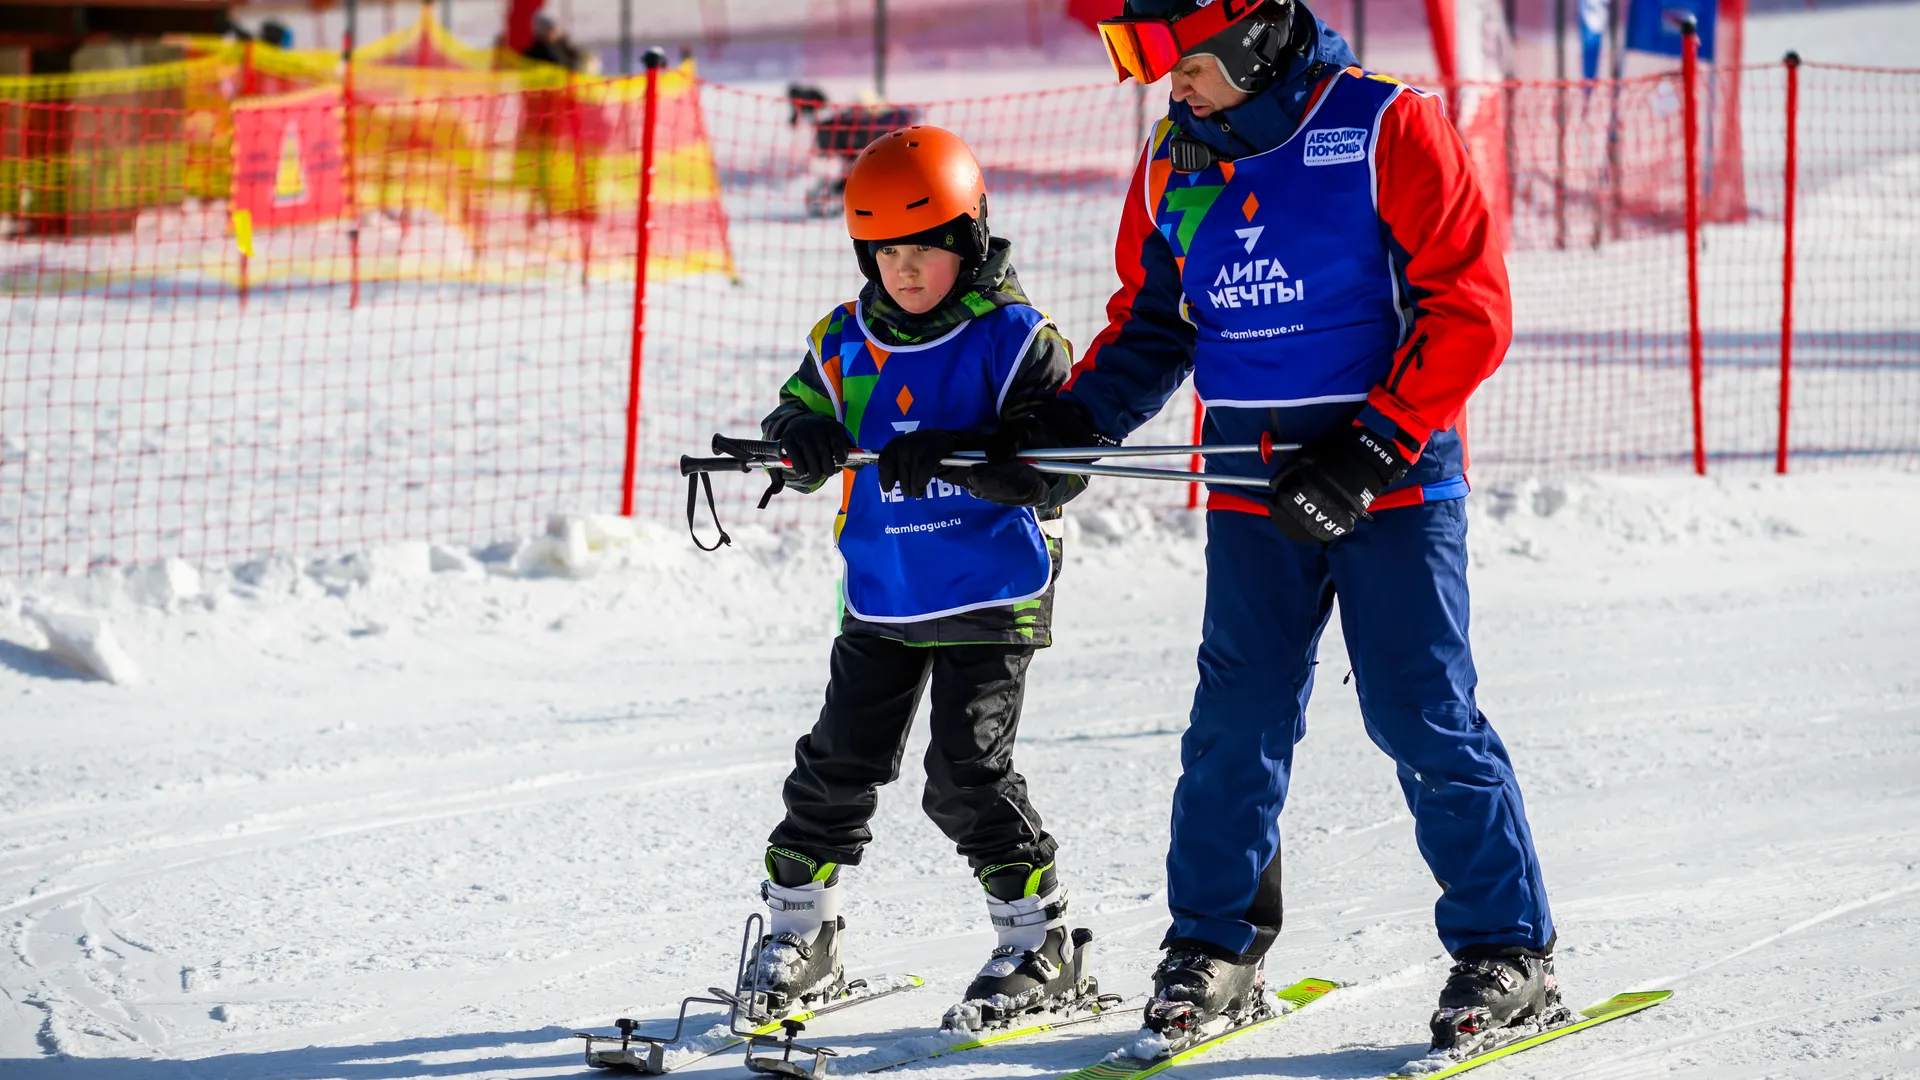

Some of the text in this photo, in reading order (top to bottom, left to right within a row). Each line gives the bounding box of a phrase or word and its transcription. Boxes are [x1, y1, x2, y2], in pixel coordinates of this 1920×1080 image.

[1306, 141, 1361, 157] ПОМОЩЬ
[1308, 130, 1366, 145] АБСОЛЮТ
[1213, 257, 1289, 287] ЛИГА
[1207, 279, 1304, 309] МЕЧТЫ
[1220, 323, 1304, 340] dreamleague.ru
[1359, 434, 1394, 465] BRADE
[878, 477, 962, 503] МЕТЫ
[884, 517, 962, 535] dreamleague.ru
[1294, 492, 1346, 536] BRADE
